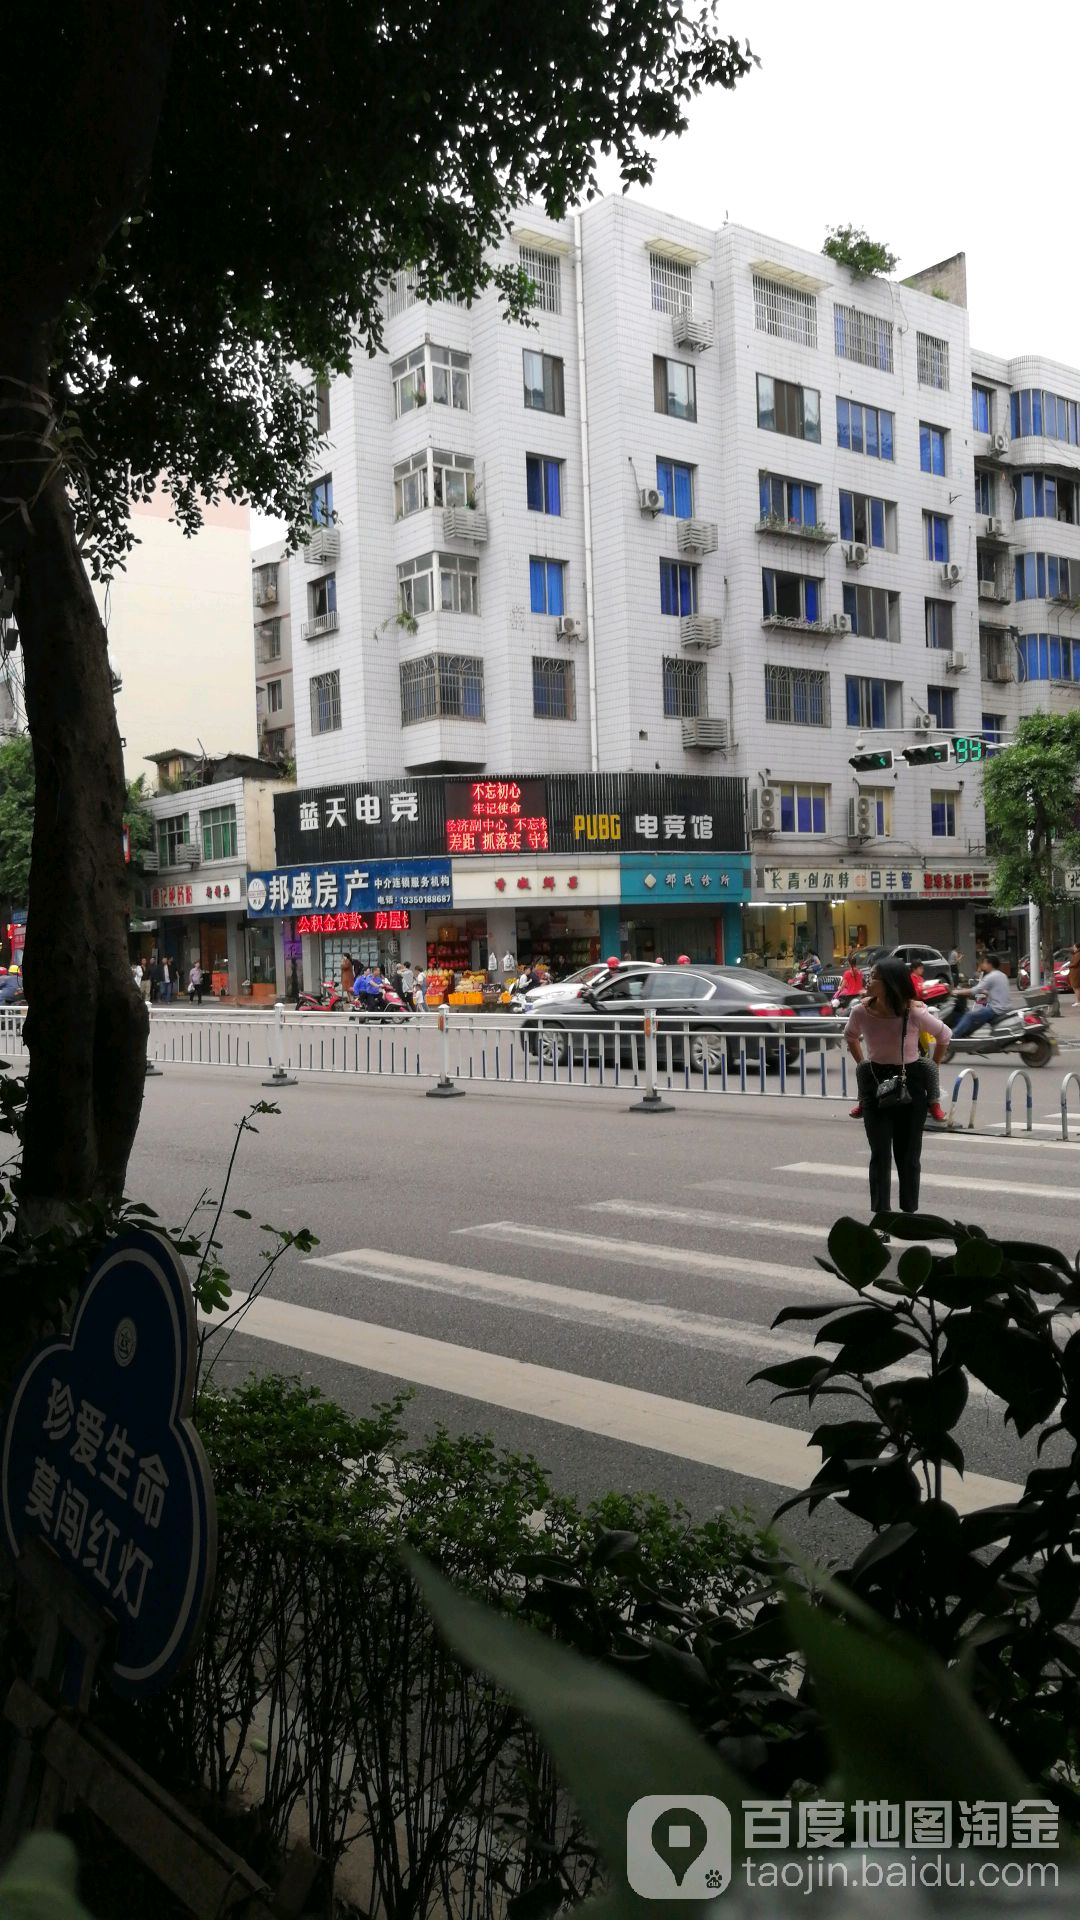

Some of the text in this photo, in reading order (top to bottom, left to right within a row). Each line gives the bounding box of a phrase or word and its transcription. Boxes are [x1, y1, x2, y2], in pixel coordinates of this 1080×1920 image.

[472, 781, 521, 800] 不忘初心
[299, 791, 419, 831] 蓝天电竞
[473, 802, 521, 815] 牢记使命
[447, 818, 508, 832] 经济副中心
[574, 813, 713, 840] PUBG 电竞馆
[449, 833, 476, 851] 差距
[482, 832, 521, 850] 抓落实
[268, 869, 369, 911] 邦盛房产
[374, 876, 450, 889] 中介连锁服务机构
[871, 871, 912, 890] 日丰管
[41, 1376, 170, 1530] 珍爱生命
[24, 1456, 154, 1619] 莫闯红灯
